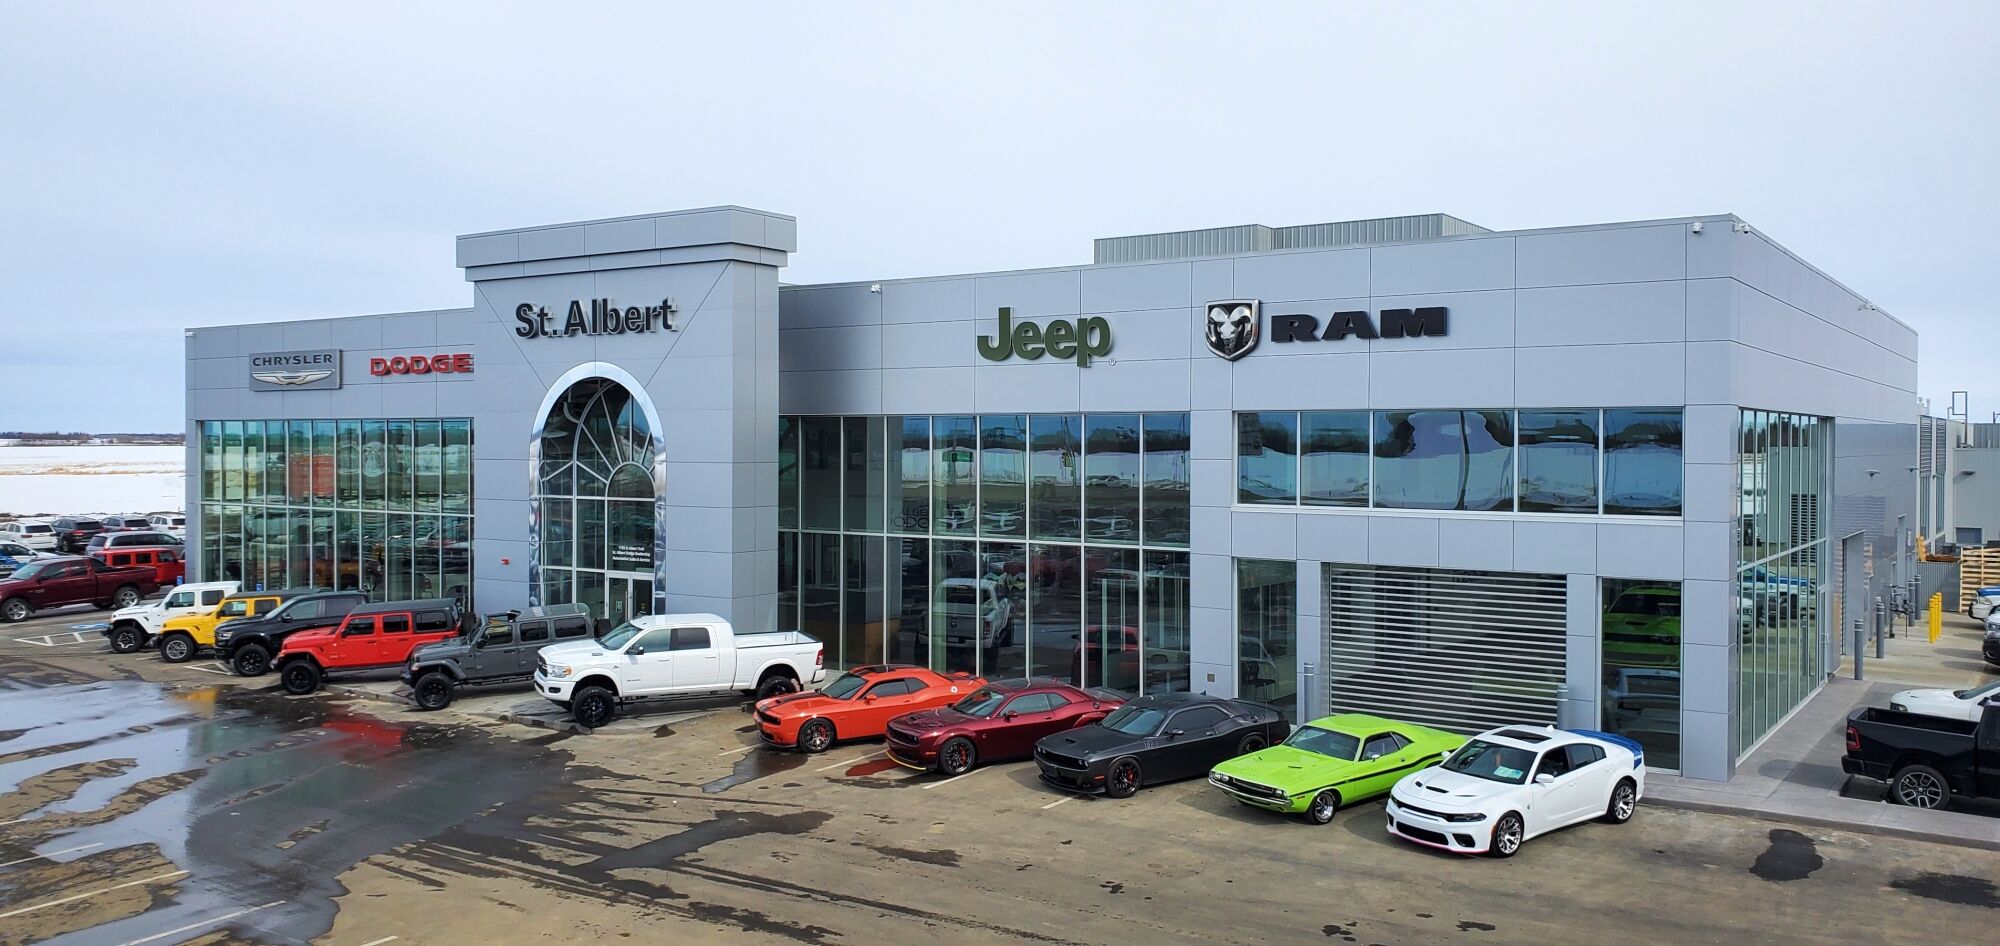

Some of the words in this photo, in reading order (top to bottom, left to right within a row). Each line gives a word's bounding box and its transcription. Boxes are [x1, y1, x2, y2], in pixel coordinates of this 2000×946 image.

[976, 307, 1112, 368] Jeep
[1271, 306, 1448, 343] RAM
[252, 354, 333, 366] CHRYSLER
[370, 353, 475, 376] DODGE
